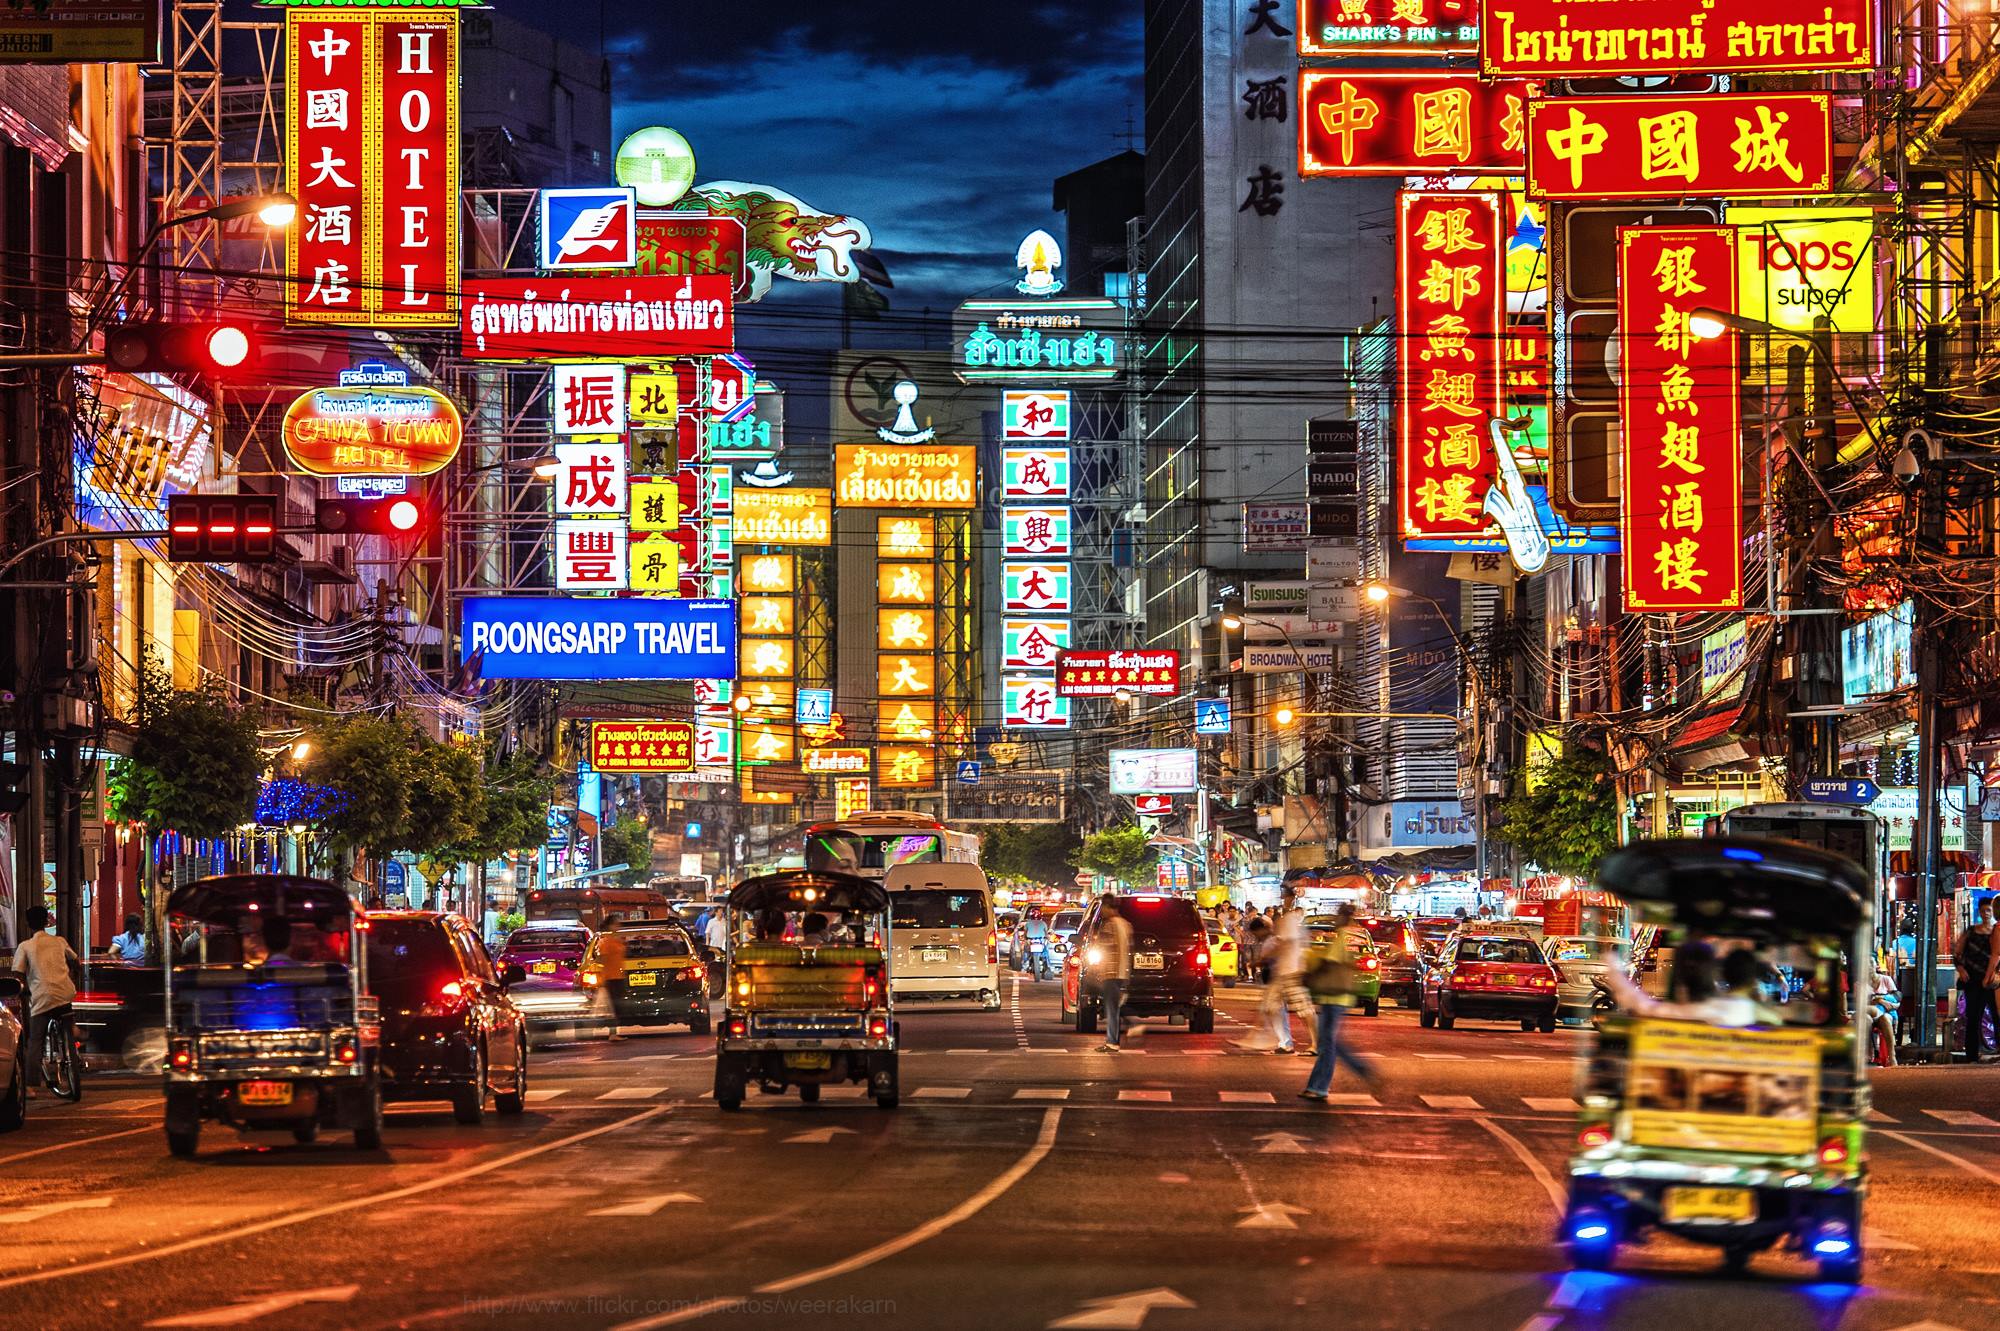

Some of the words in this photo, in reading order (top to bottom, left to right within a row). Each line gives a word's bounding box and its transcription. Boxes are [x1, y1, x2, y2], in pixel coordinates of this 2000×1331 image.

[1324, 25, 1400, 41] SHARK'S
[1407, 27, 1436, 41] FIN
[1495, 11, 1706, 62] ไชน่าทาวน์
[1727, 8, 1858, 57] สกาล่า
[1546, 105, 1804, 190] 中國城
[304, 28, 356, 305] 中國大酒店
[397, 33, 434, 306] HOTEL
[1746, 234, 1854, 284] Tops
[1778, 287, 1852, 306] super
[470, 277, 724, 351] รุ่งทรัพย์การท่องเที่ยว
[1414, 207, 1485, 525] 銀都魚翅酒樓
[294, 417, 372, 442] CHINA
[381, 418, 453, 445] TOWN
[1311, 432, 1354, 442] CITIZEN
[333, 446, 410, 469] HOTEL
[564, 376, 617, 582] 振成豐
[1312, 472, 1355, 483] RADO
[1317, 513, 1350, 523] MIDO
[1020, 400, 1053, 721] 和成興大金行
[1321, 597, 1346, 605] BALL
[473, 622, 627, 654] ROONGSARP
[634, 622, 725, 654] TRAVEL
[1250, 654, 1303, 666] BROADWAY
[1307, 654, 1333, 666] HOTE
[1407, 652, 1446, 667] MIDO
[1811, 782, 1848, 791] เยาวราช
[1856, 784, 1867, 797] 2
